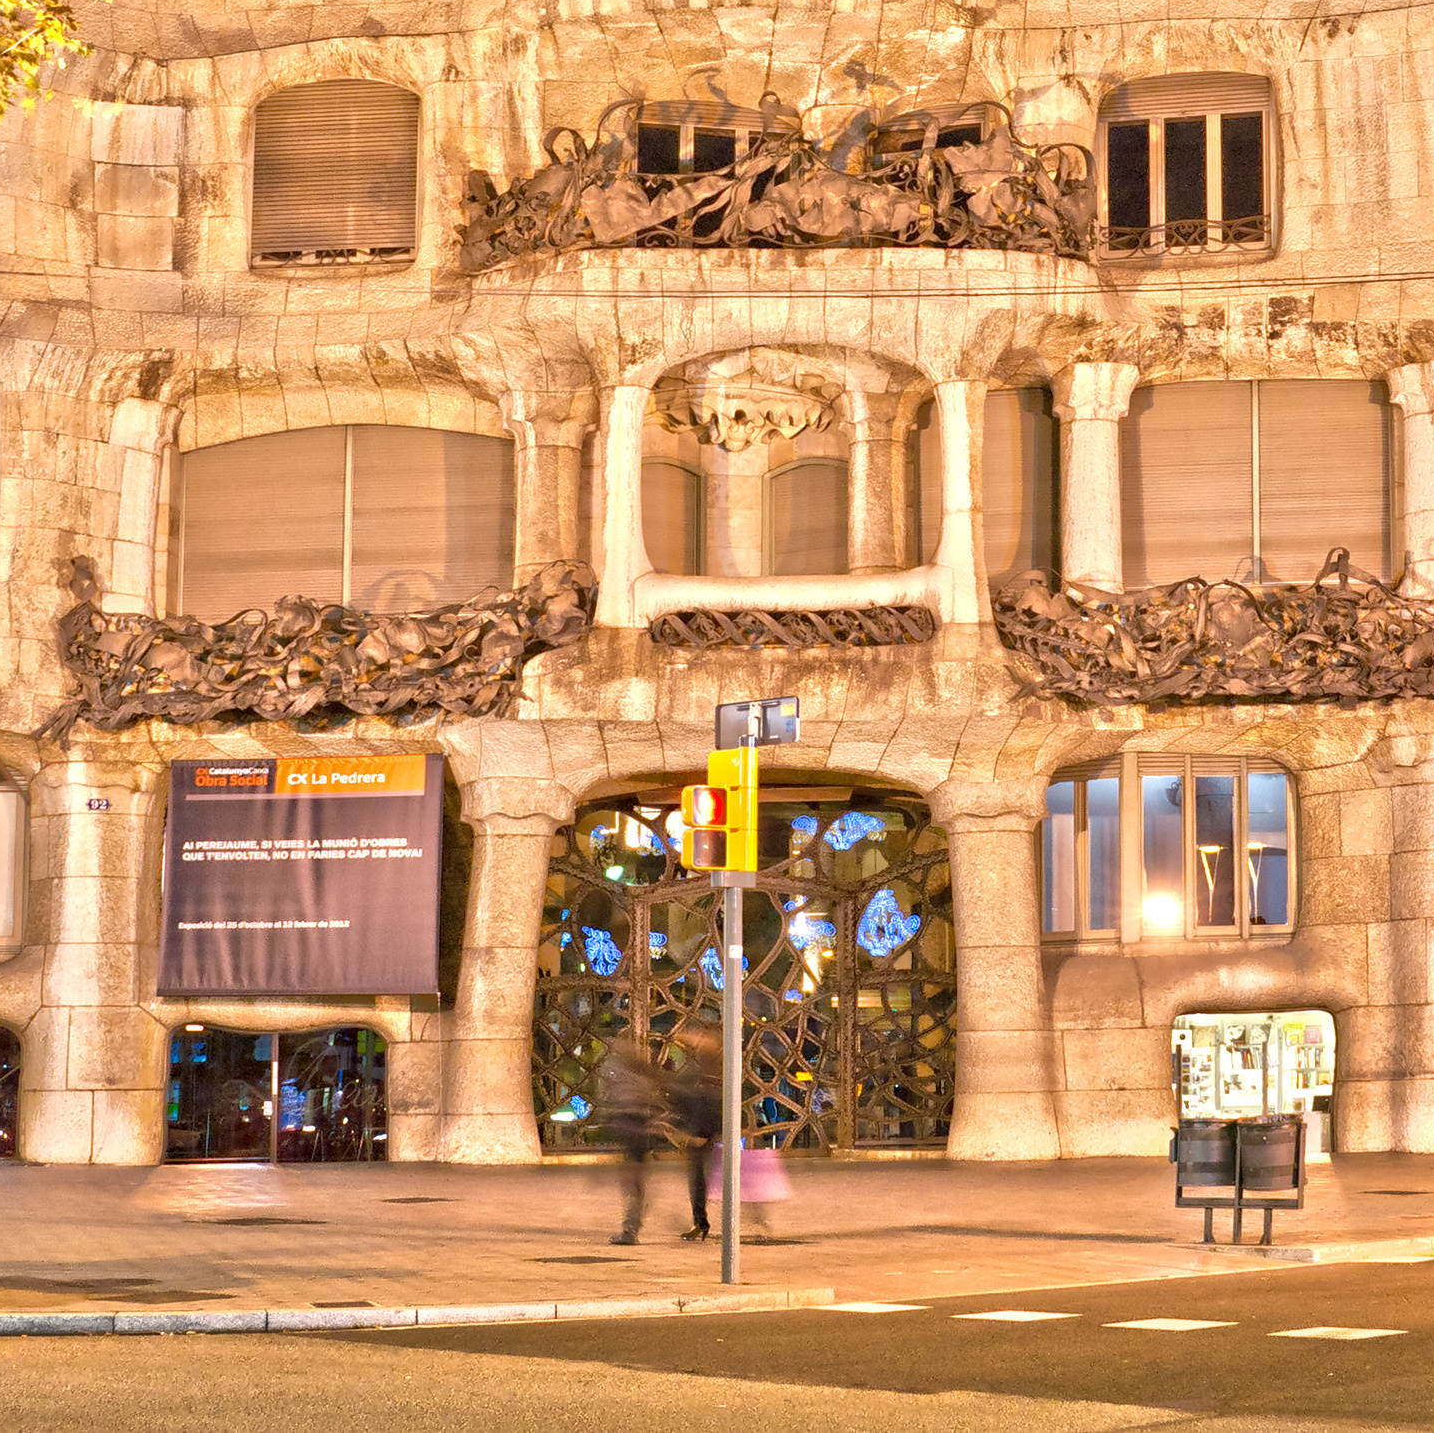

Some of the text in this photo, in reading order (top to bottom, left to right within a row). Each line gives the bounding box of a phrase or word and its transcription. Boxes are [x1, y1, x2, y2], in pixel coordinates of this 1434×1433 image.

[209, 767, 269, 776] CatalunyaCaixa
[195, 774, 268, 787] Obra Social
[287, 772, 386, 785] CX La Pedrera
[91, 799, 107, 810] 92
[183, 837, 407, 850] AI PEREJAUME, SI VEIES LA MUNIÓ D'OBRES
[182, 848, 423, 861] QUE T'ENVOLTEN, NO EN FARIES CAP DE NOVA!
[178, 921, 213, 930] Exposició
[213, 921, 226, 929] del
[227, 921, 238, 929] 25
[238, 921, 273, 929] d'octubre
[282, 920, 293, 928] 12
[317, 920, 328, 928] de
[328, 920, 350, 928] 2012
